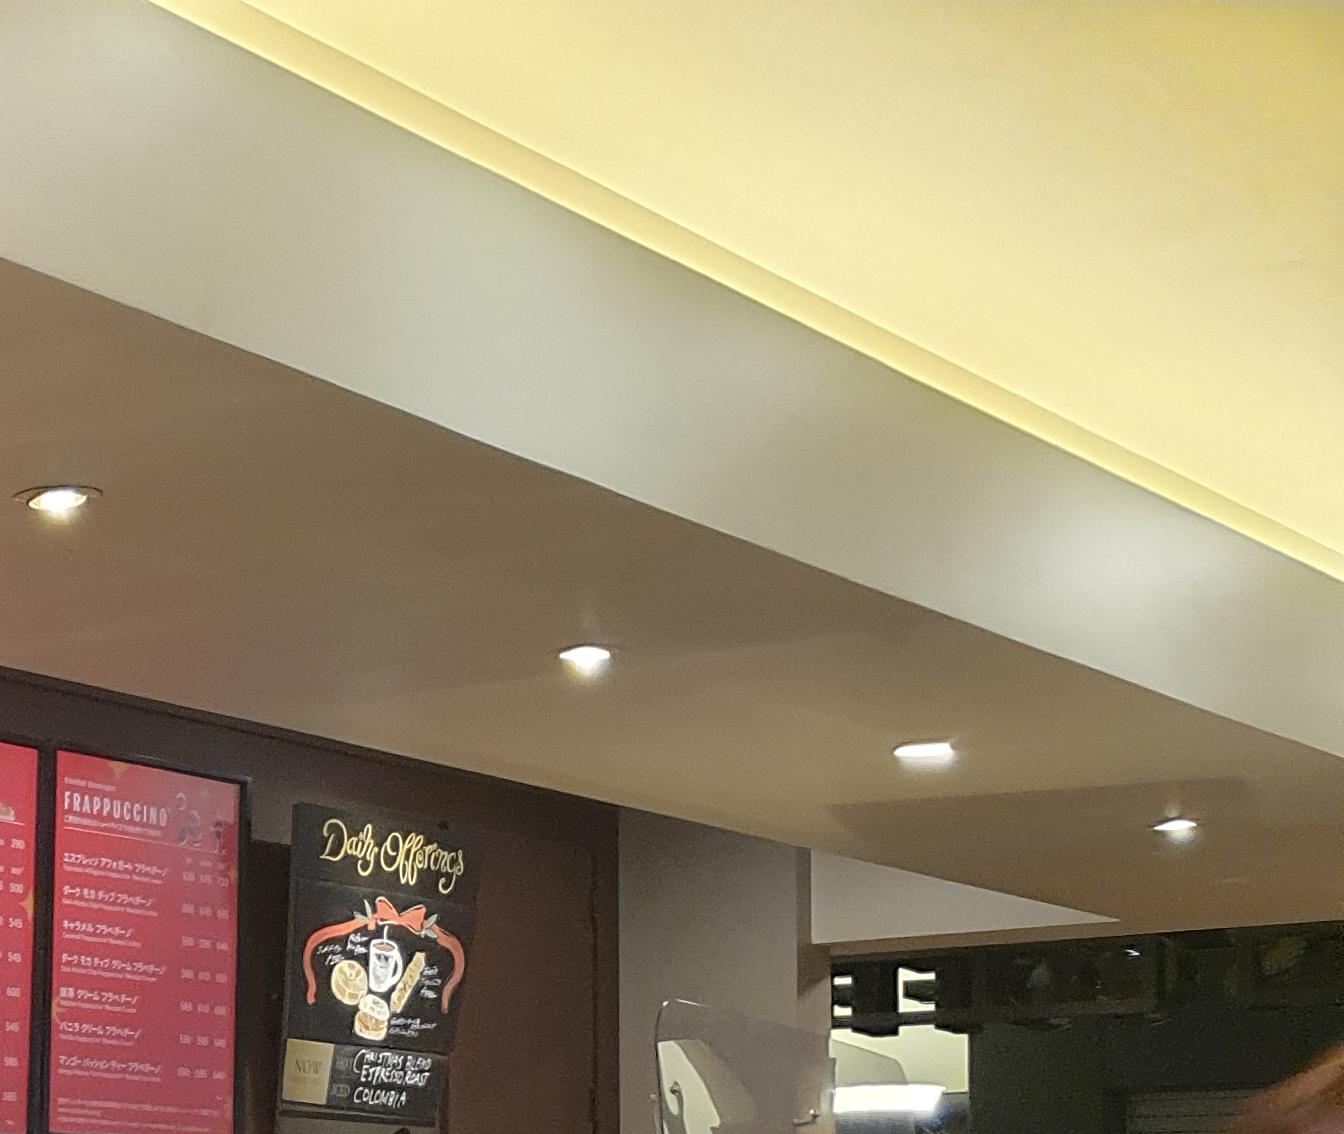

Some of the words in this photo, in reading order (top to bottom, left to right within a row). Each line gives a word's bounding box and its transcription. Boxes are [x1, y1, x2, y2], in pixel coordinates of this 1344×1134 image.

[64, 791, 168, 826] FRAPPUCCINO
[320, 818, 378, 876] Daily
[381, 832, 464, 894] Offerings
[353, 1049, 404, 1073] CHRISTMAS
[405, 1054, 432, 1072] BLEND
[360, 1065, 403, 1085] ESPRESSO
[403, 1071, 430, 1087] ROAST
[353, 1087, 407, 1108] COLOMBIA
